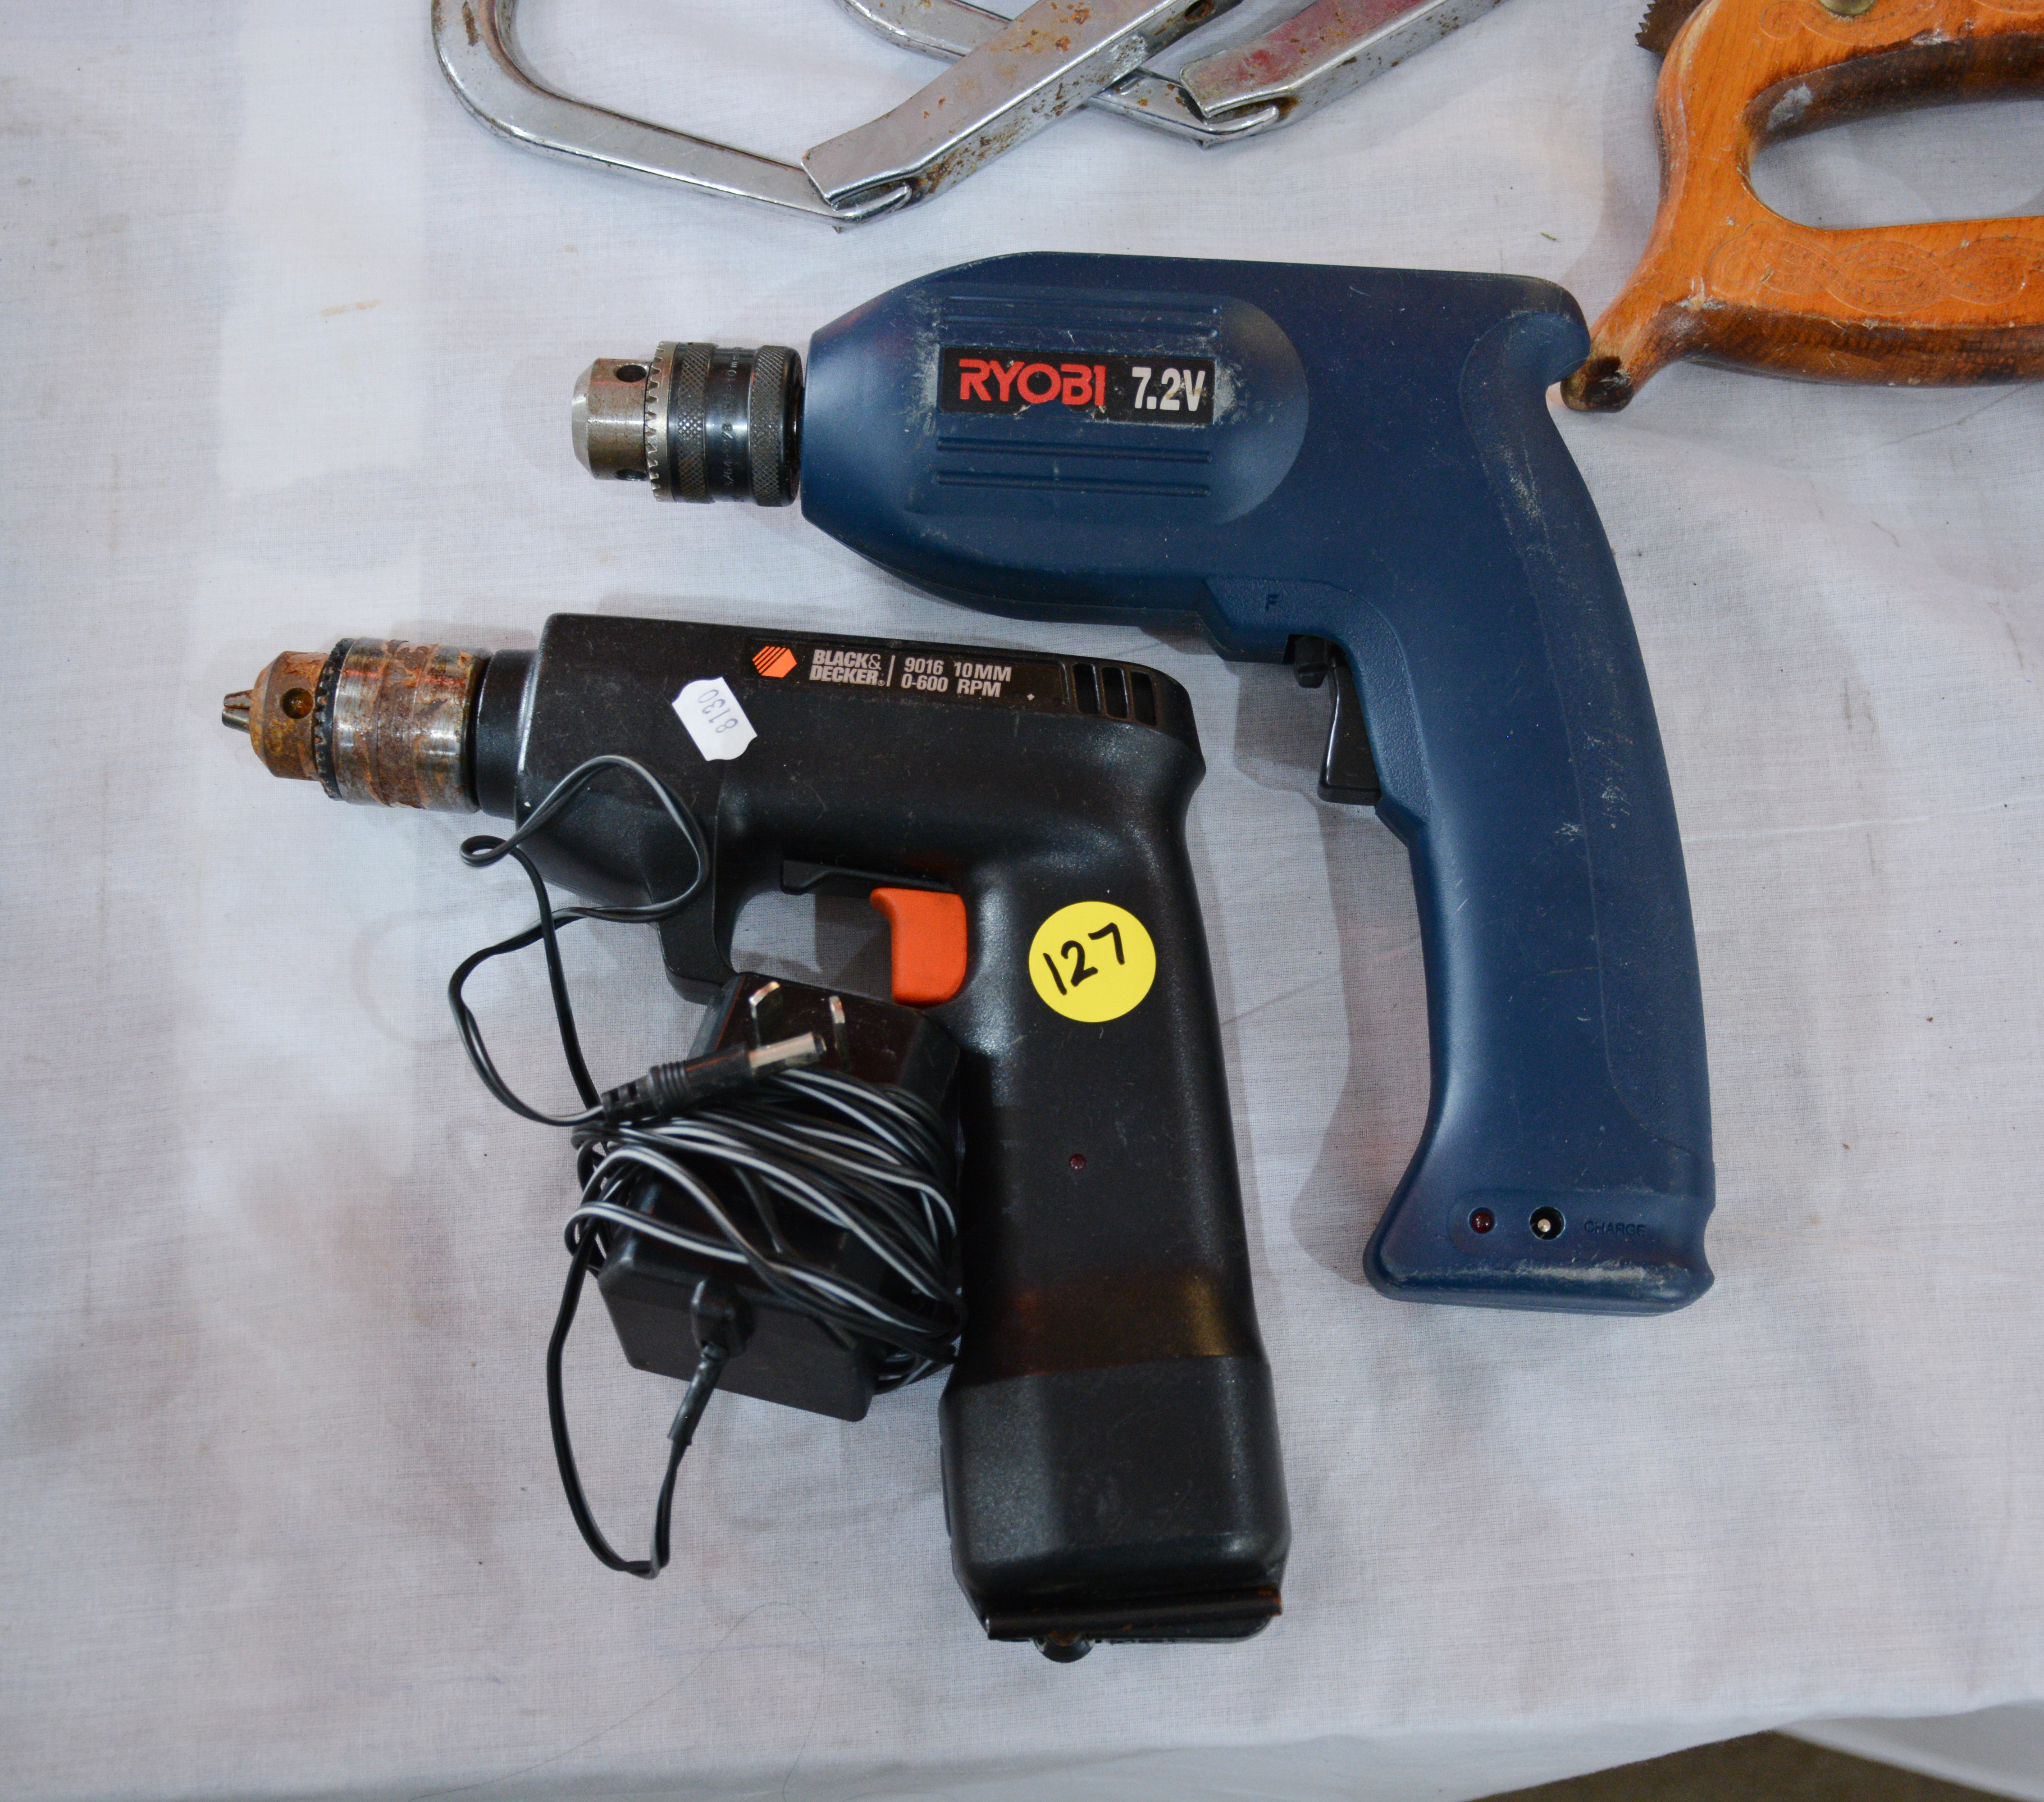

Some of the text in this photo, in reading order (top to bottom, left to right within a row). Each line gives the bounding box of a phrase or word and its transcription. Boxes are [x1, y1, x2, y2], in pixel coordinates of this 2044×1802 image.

[959, 359, 1205, 411] RYOBI 7.2V
[904, 657, 944, 675] 9016
[901, 673, 1002, 698] 0-600 RPM
[698, 689, 738, 733] 8130
[1043, 922, 1125, 996] 127
[1583, 1220, 1647, 1237] CHARGE
